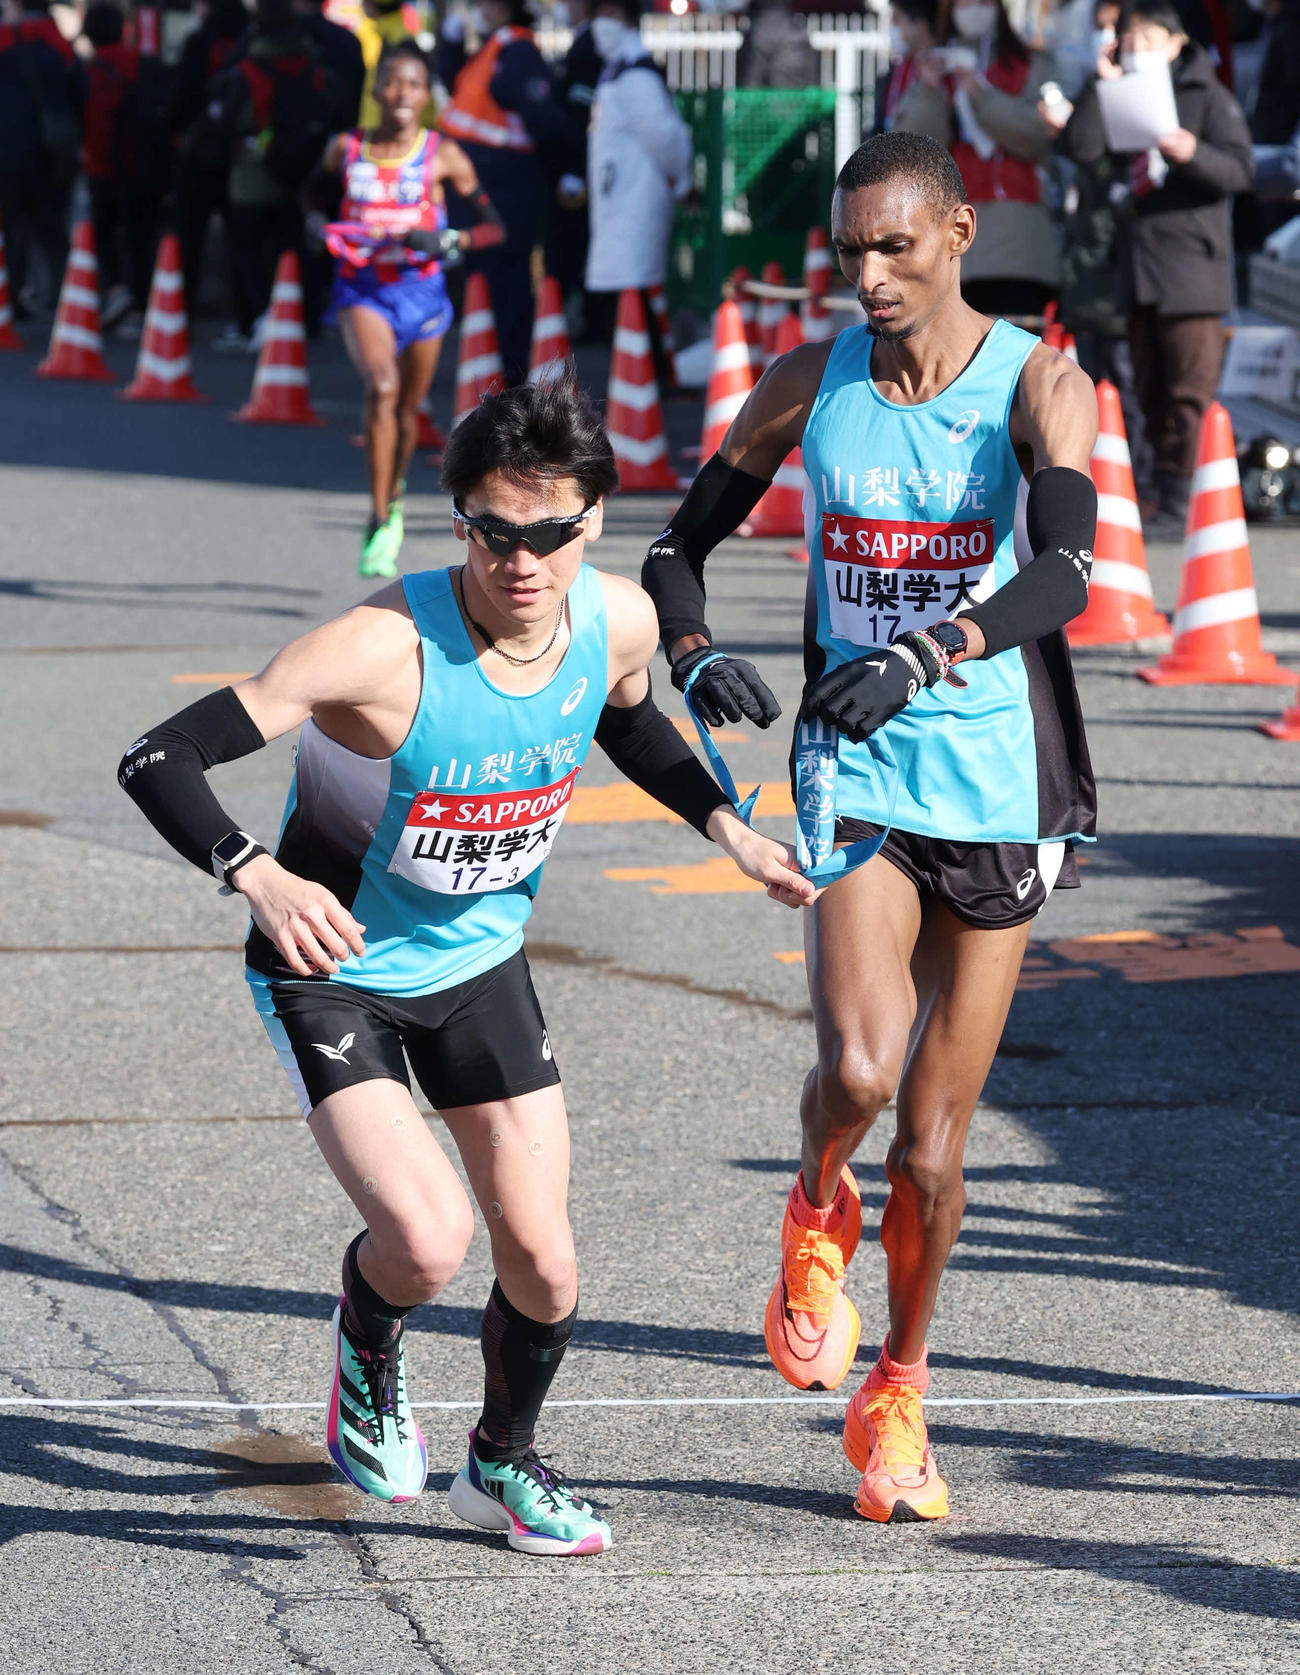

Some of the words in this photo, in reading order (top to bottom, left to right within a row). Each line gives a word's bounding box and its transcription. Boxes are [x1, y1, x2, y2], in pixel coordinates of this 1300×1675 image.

[821, 466, 986, 511] 山梨学院
[855, 529, 987, 561] SAPPORO
[836, 566, 981, 613] 山梨学大
[428, 731, 583, 790] 山梨学院
[454, 780, 573, 825] SAPPORO
[411, 819, 557, 865] 山梨学大
[451, 866, 520, 891] 17-3
